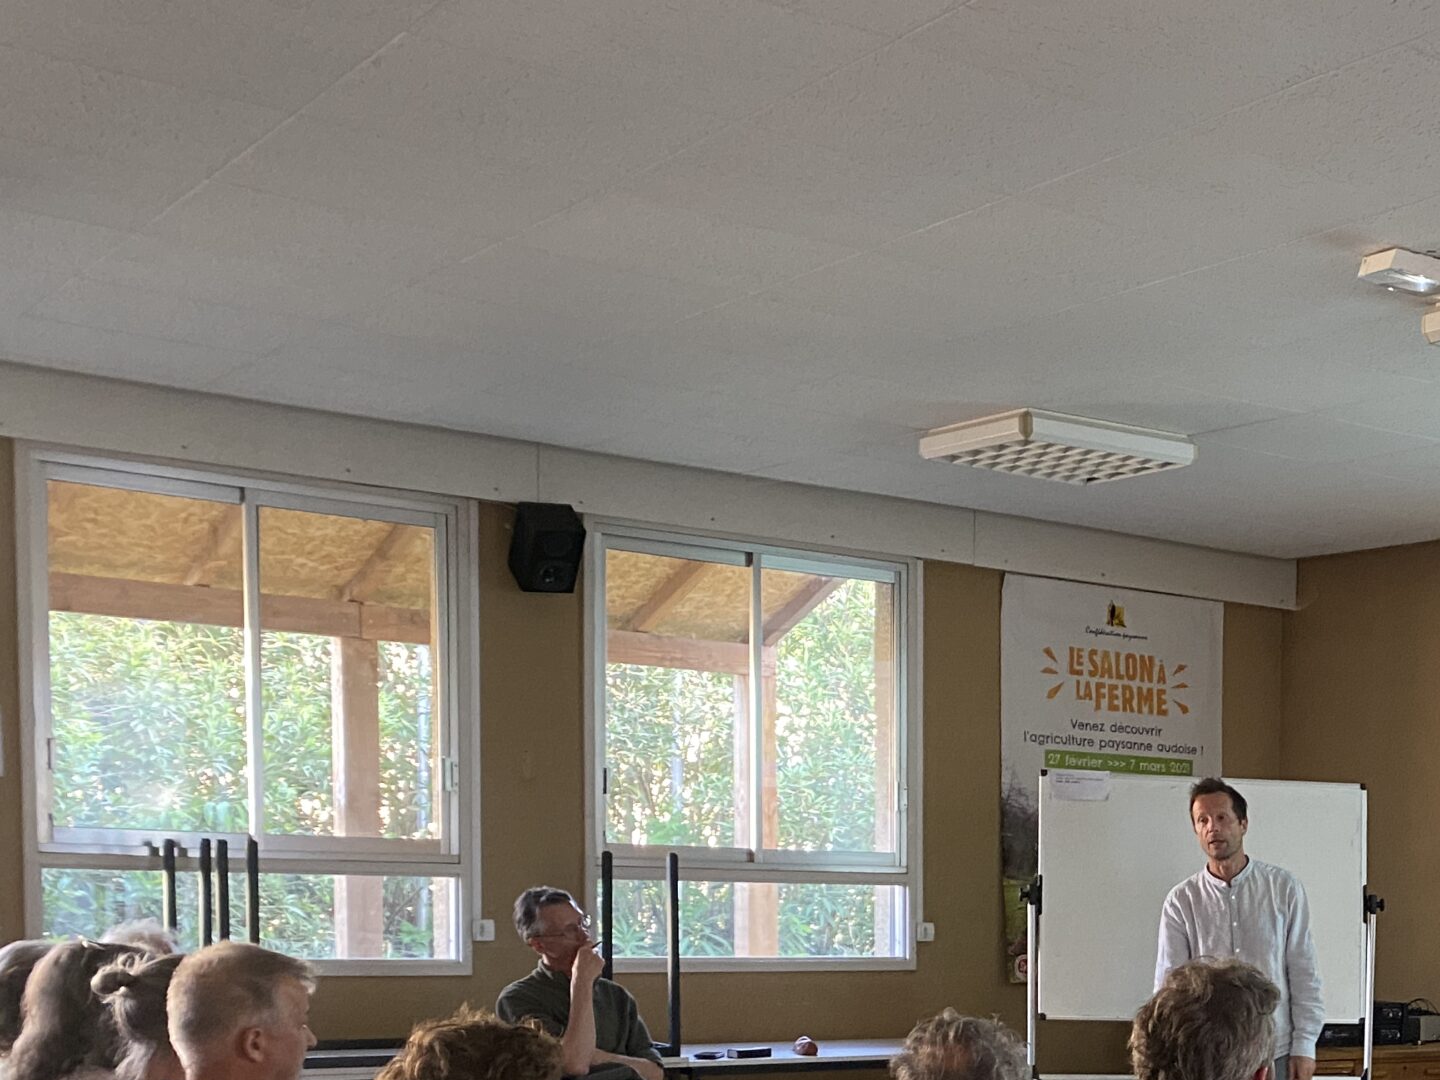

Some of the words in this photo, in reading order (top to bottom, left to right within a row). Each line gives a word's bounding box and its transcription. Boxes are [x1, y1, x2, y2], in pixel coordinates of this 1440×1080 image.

[1068, 646, 1084, 676] LE
[1087, 648, 1155, 683] SALON
[1075, 680, 1093, 700] LA
[1094, 682, 1169, 716] FERME
[1070, 718, 1105, 733] Venez
[1110, 721, 1163, 737] découvrir
[1023, 730, 1095, 747] l'agriculture
[1100, 738, 1153, 753] paysanne
[1157, 742, 1197, 756] audoise
[1047, 753, 1061, 765] 27
[1129, 760, 1136, 770] 7
[1139, 761, 1165, 772] mars
